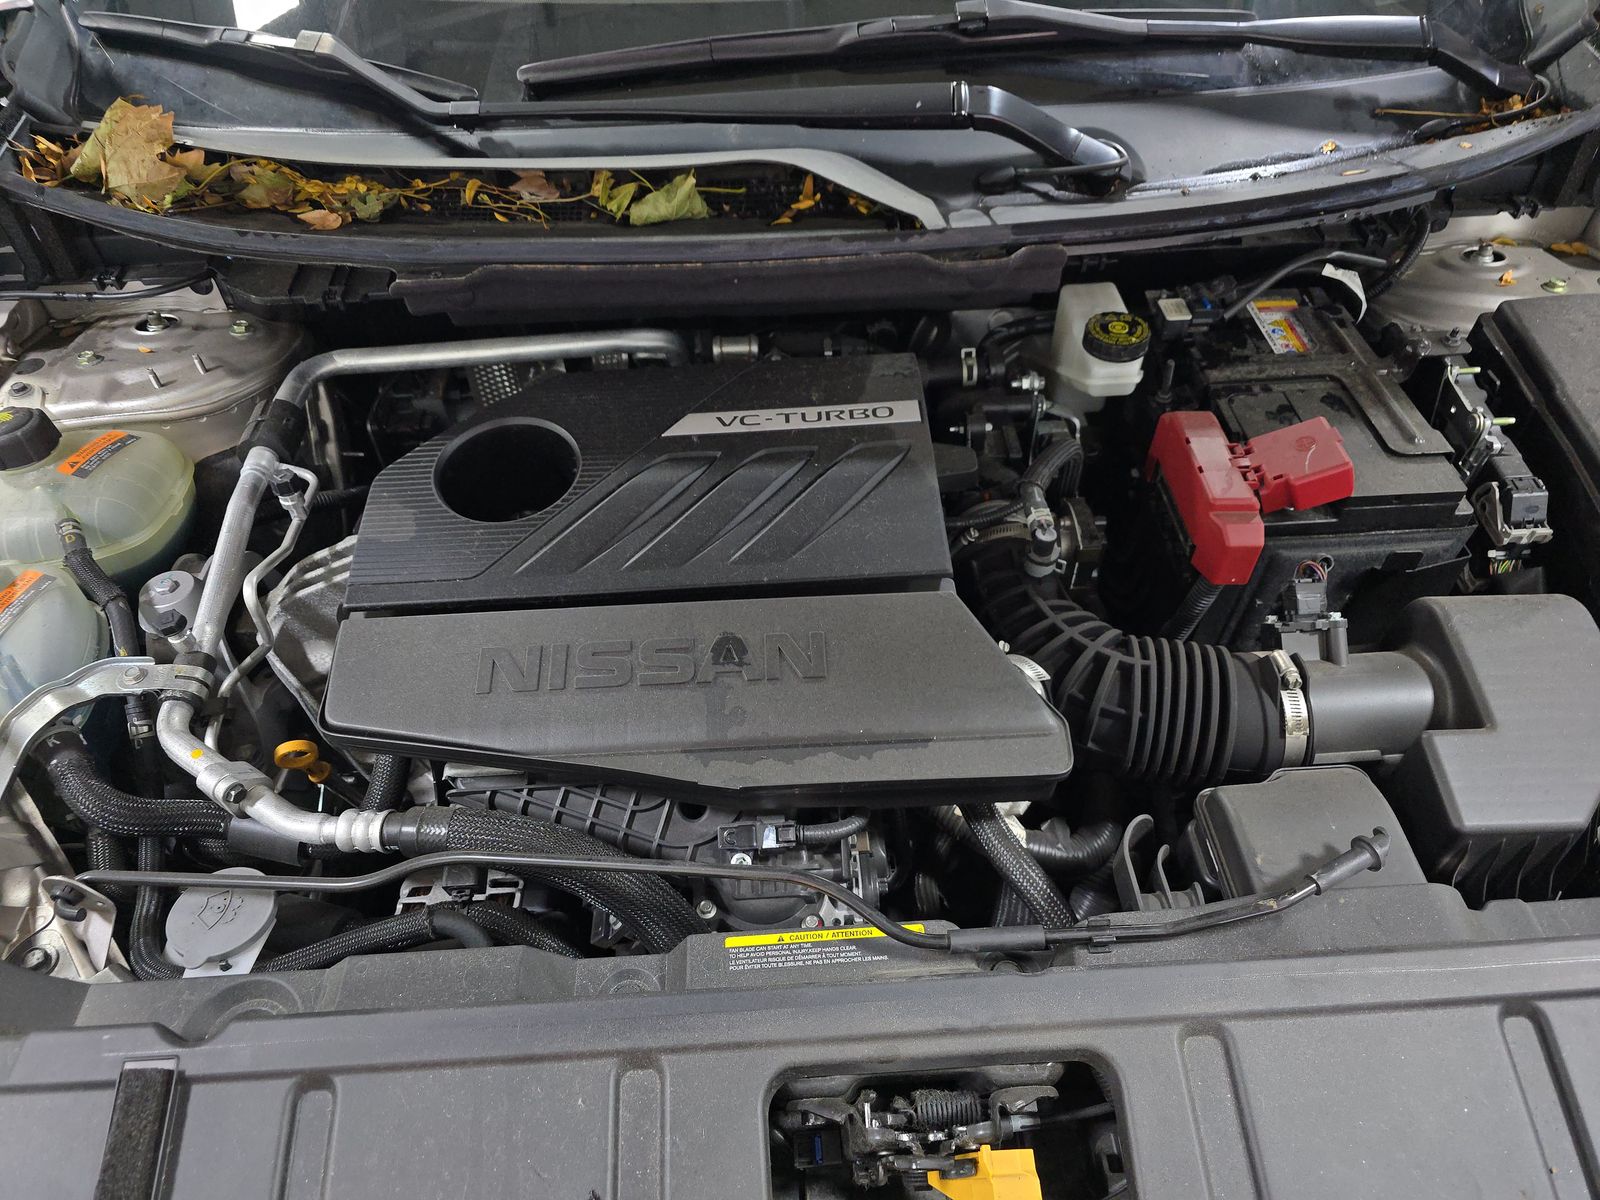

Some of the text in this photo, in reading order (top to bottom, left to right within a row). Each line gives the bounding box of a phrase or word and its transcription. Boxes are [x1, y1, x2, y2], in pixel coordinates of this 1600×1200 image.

[715, 405, 895, 428] VC-TURBO
[474, 630, 827, 695] NISSAN
[789, 932, 824, 941] CAUTION
[831, 930, 873, 938] ATTENTION
